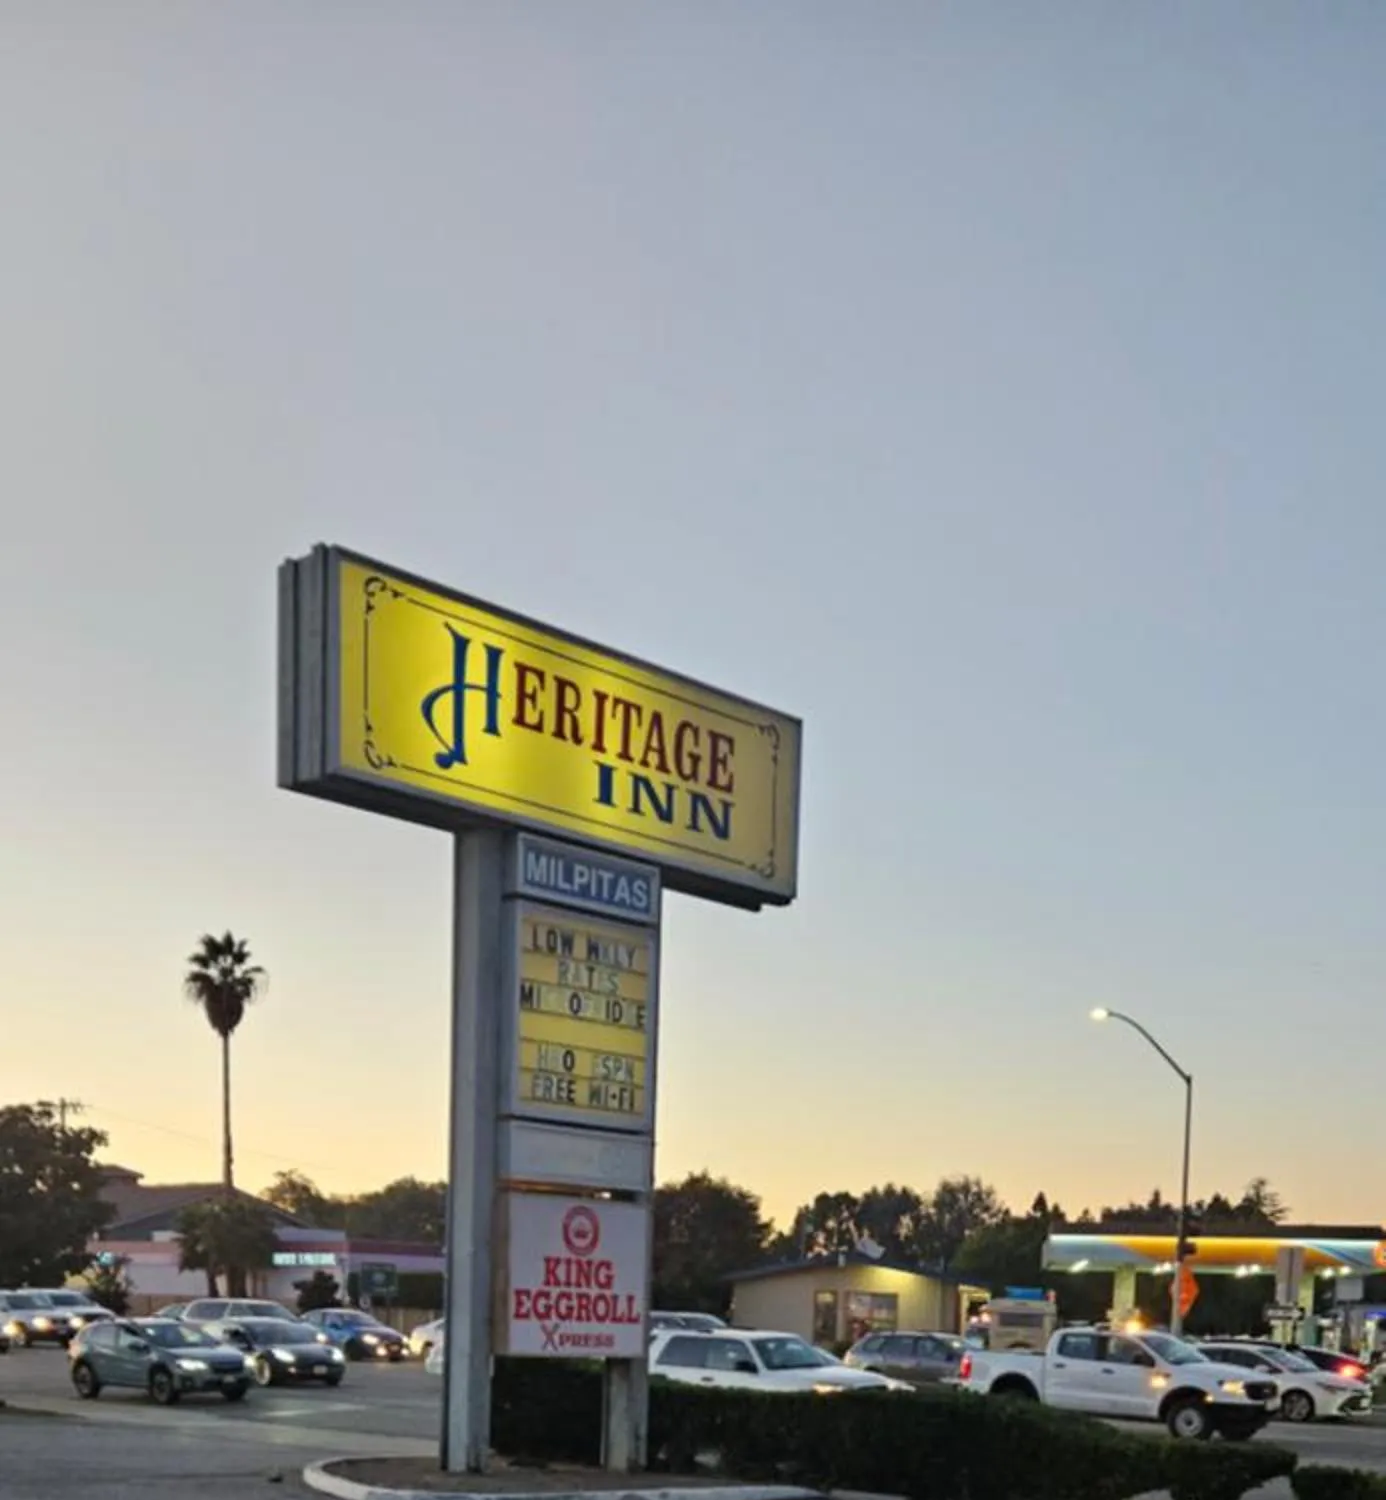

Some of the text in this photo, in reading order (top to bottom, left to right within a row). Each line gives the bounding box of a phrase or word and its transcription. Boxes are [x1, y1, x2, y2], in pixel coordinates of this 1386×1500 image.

[420, 622, 735, 794] HERITAGE
[593, 760, 735, 840] INN
[526, 851, 649, 909] MILPITAS
[532, 925, 575, 957] LOW
[557, 961, 619, 995] RATS
[538, 1041, 575, 1073] HO
[532, 1073, 576, 1105] FREE
[543, 1256, 616, 1290] KING
[513, 1289, 640, 1324] EGGROLL
[540, 1323, 616, 1351] XPRESS
